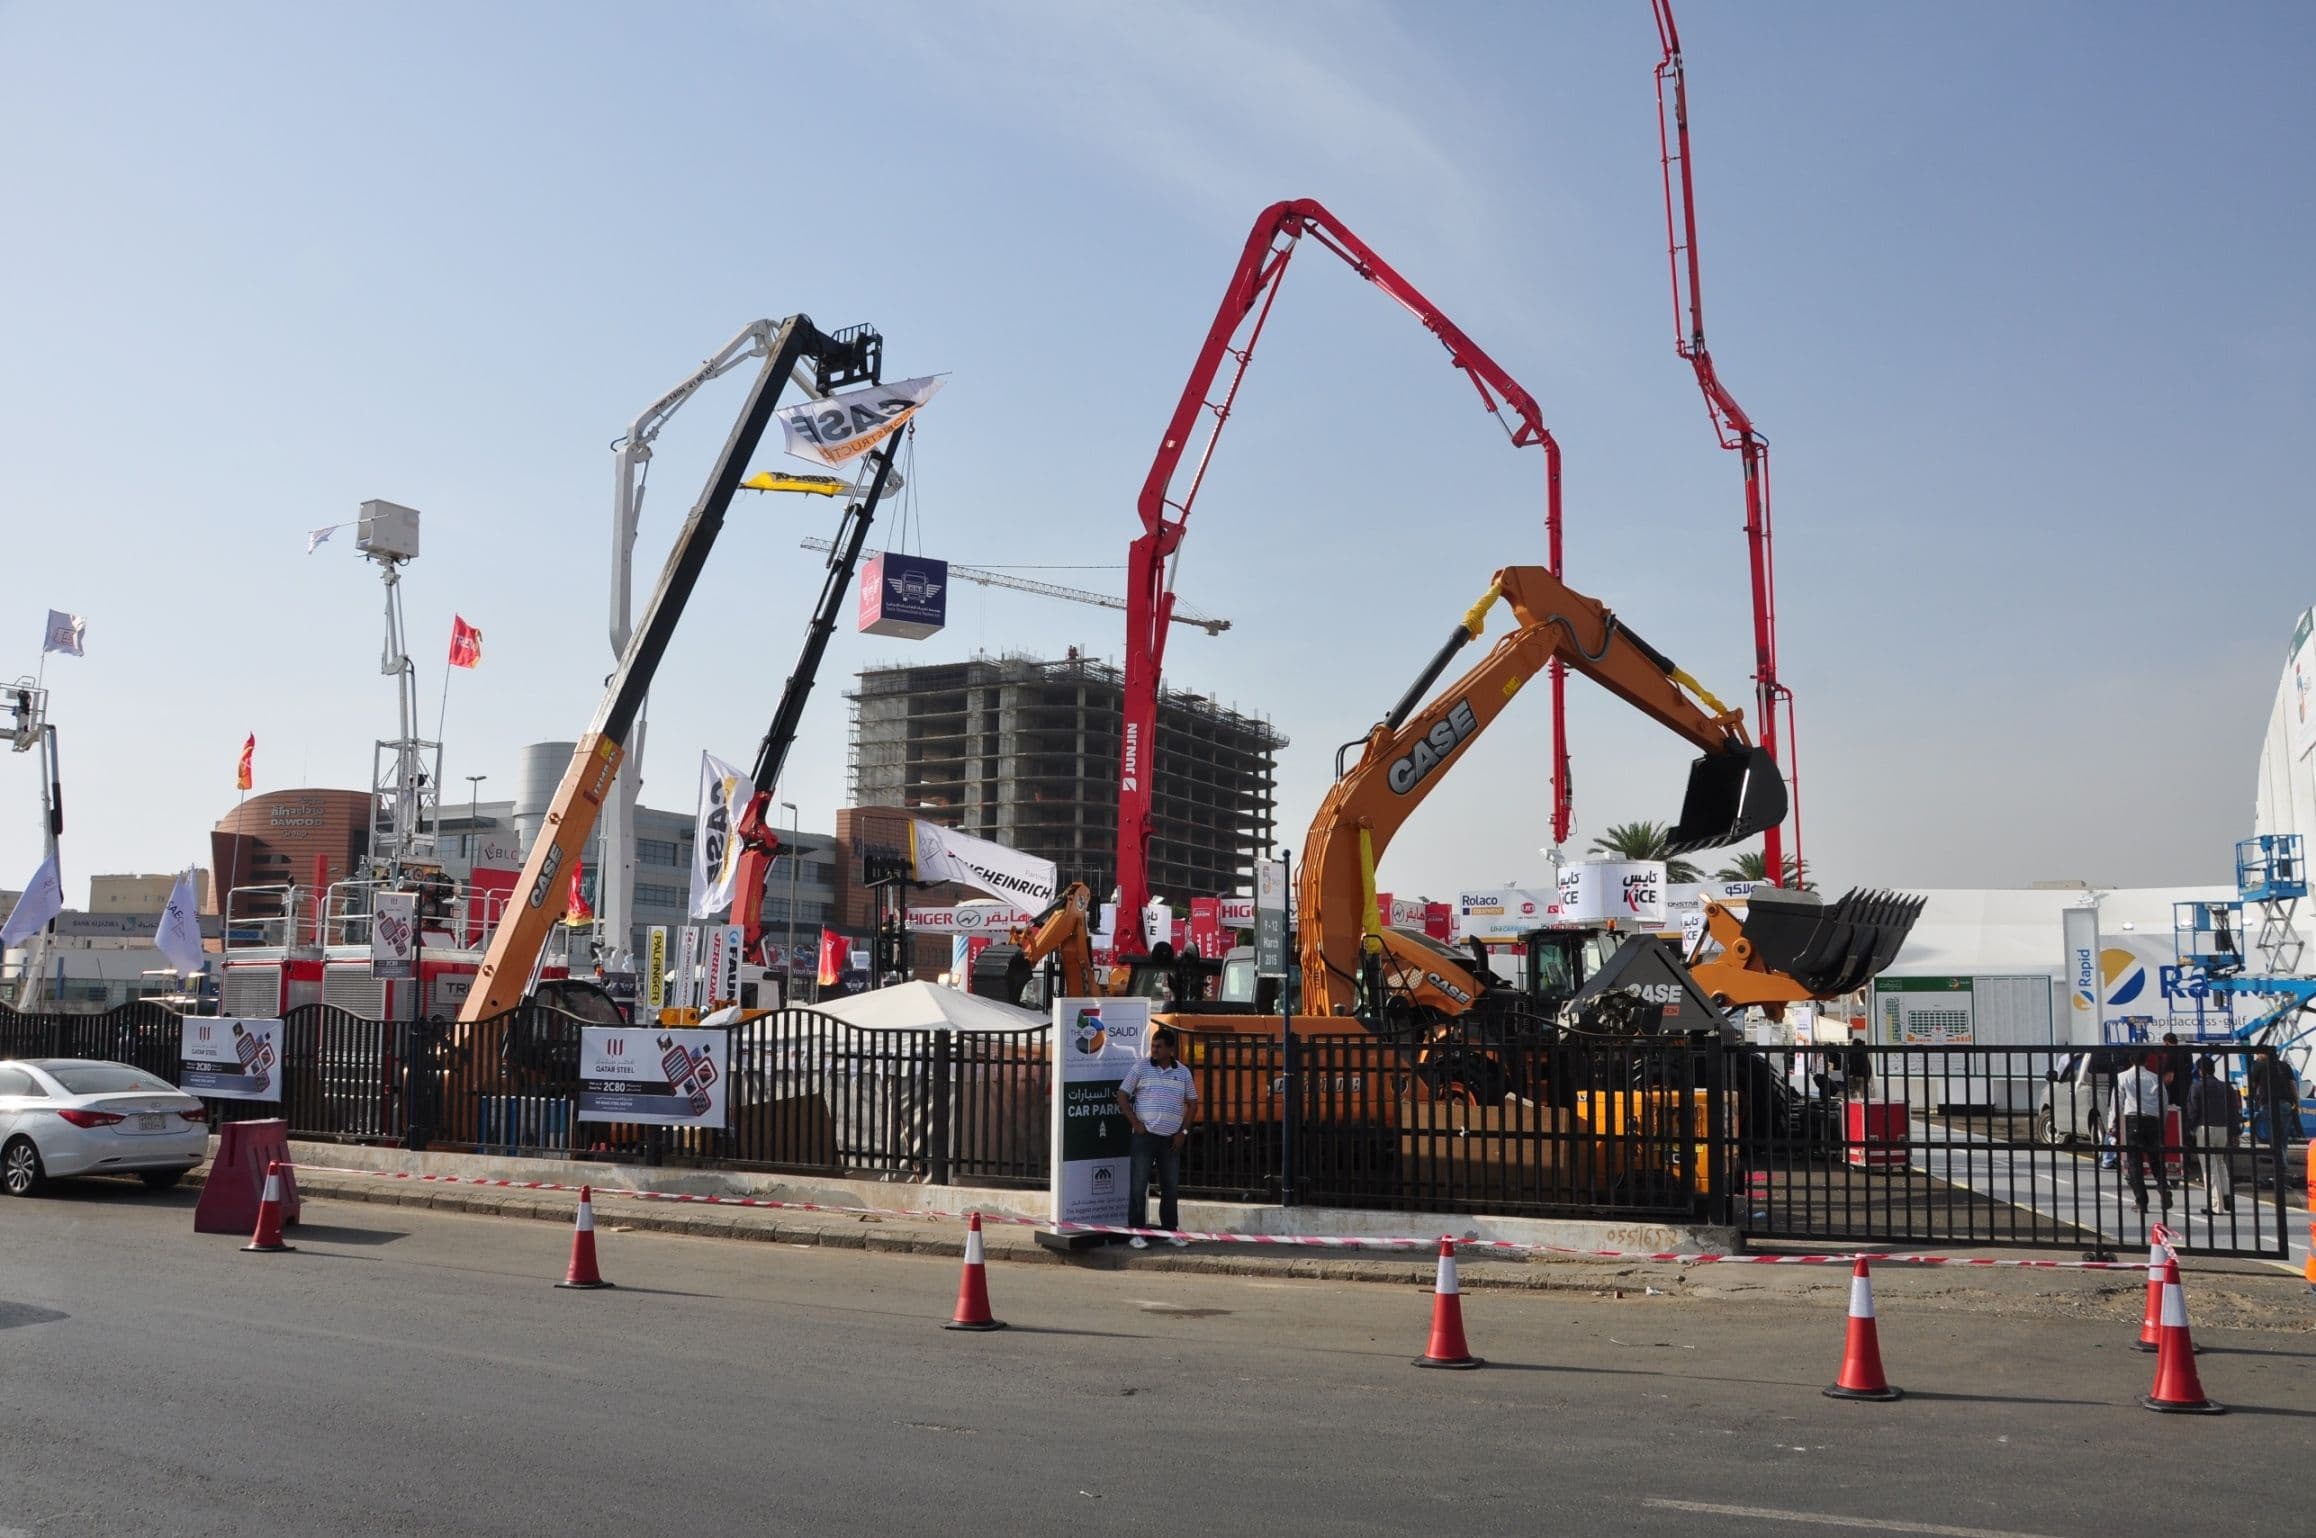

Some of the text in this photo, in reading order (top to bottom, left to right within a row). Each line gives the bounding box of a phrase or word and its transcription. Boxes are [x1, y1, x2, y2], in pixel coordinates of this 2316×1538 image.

[1125, 722, 1138, 775] JUNJIN
[1388, 699, 1478, 795] CASE
[271, 818, 322, 826] DAWOOD
[530, 844, 564, 909] CASE
[1623, 870, 1658, 887] كايس
[1462, 895, 1498, 906] Rolaco
[1222, 905, 1255, 918] HIG
[909, 913, 953, 925] HIGER
[652, 935, 662, 1001] PALFINGER
[2077, 949, 2093, 988] Rapid
[1427, 972, 1471, 1004] CASE
[2151, 1015, 2247, 1031] apidaccss-gulf
[1108, 1027, 1138, 1038] SAUDI
[595, 1065, 635, 1074] QATAR STEEL
[603, 1082, 626, 1092] 2C80
[1068, 1088, 1110, 1102] السيارات
[1068, 1104, 1121, 1117] CAR PARK
